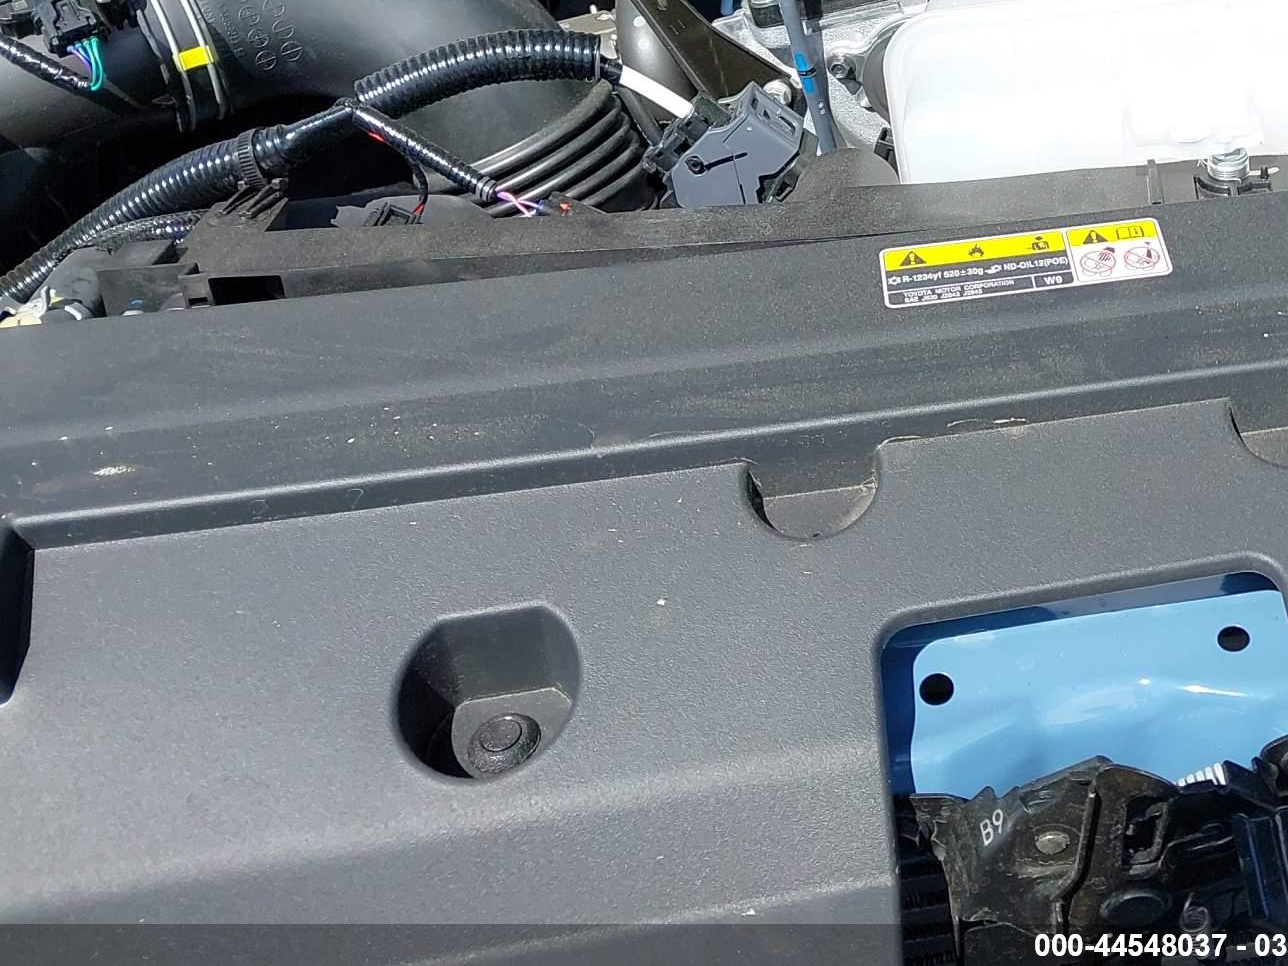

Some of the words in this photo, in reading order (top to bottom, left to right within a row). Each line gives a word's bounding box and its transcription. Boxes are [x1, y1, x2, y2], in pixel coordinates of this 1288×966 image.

[902, 271, 942, 283] R-1234yf
[904, 289, 932, 298] TOYOTA
[935, 285, 962, 294] MOTOR
[963, 279, 1015, 290] CORPORATION
[980, 809, 1003, 846] B9
